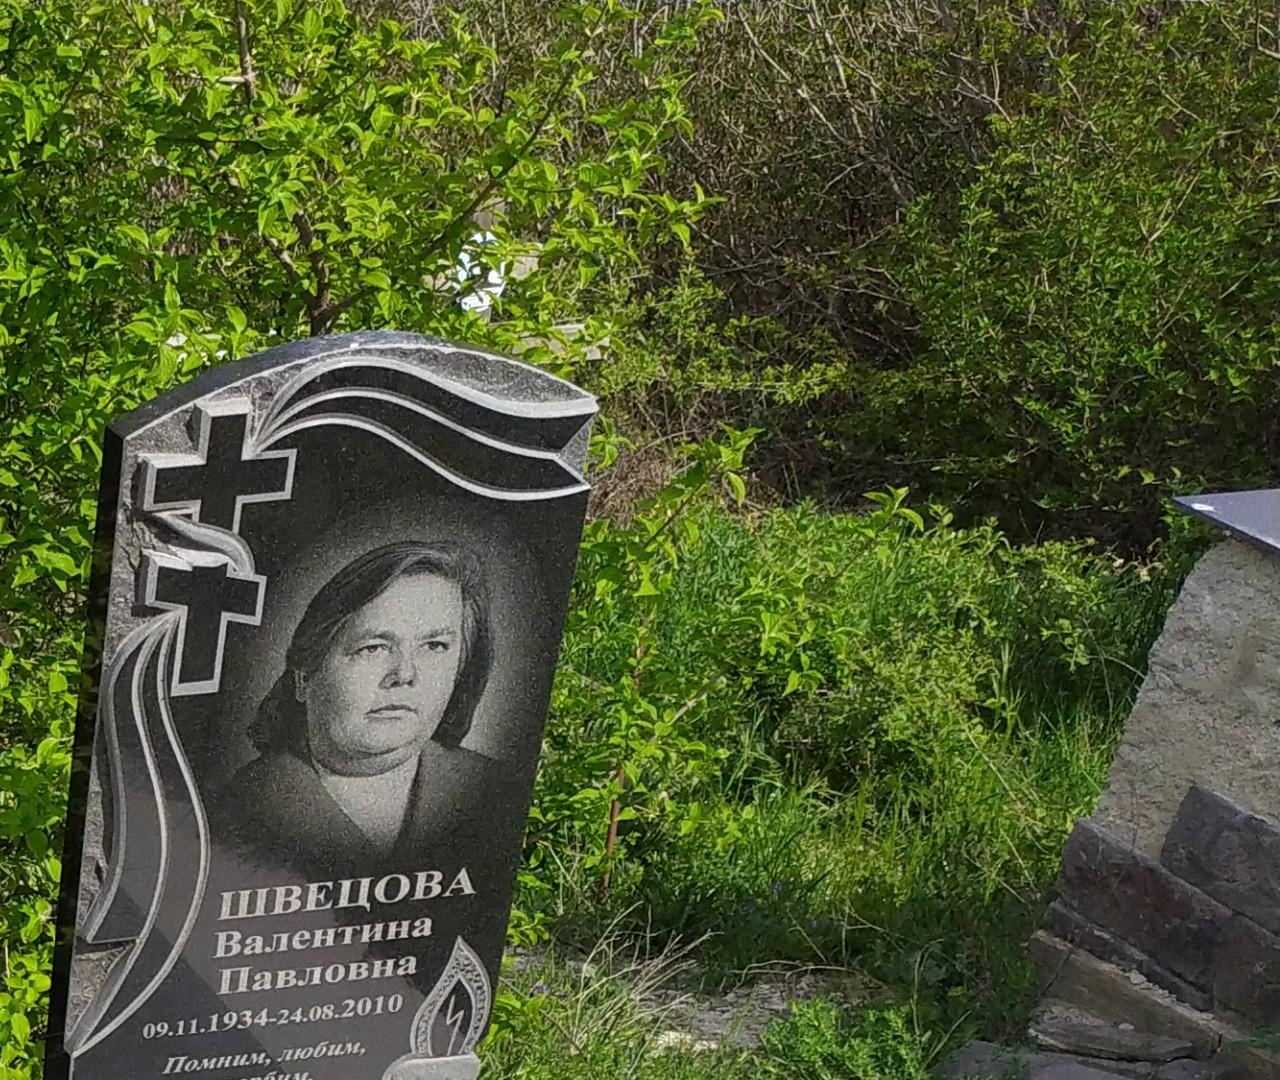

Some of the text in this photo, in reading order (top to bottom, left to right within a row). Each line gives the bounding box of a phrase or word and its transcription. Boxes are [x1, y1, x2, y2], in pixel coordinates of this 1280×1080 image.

[217, 867, 476, 921] ШВЕЦОВА
[212, 916, 433, 959] Валентина
[216, 955, 418, 996] Павловна
[142, 993, 404, 1040] 09.11.1934-24.08.2010
[162, 1040, 366, 1075] Помним, любим,
